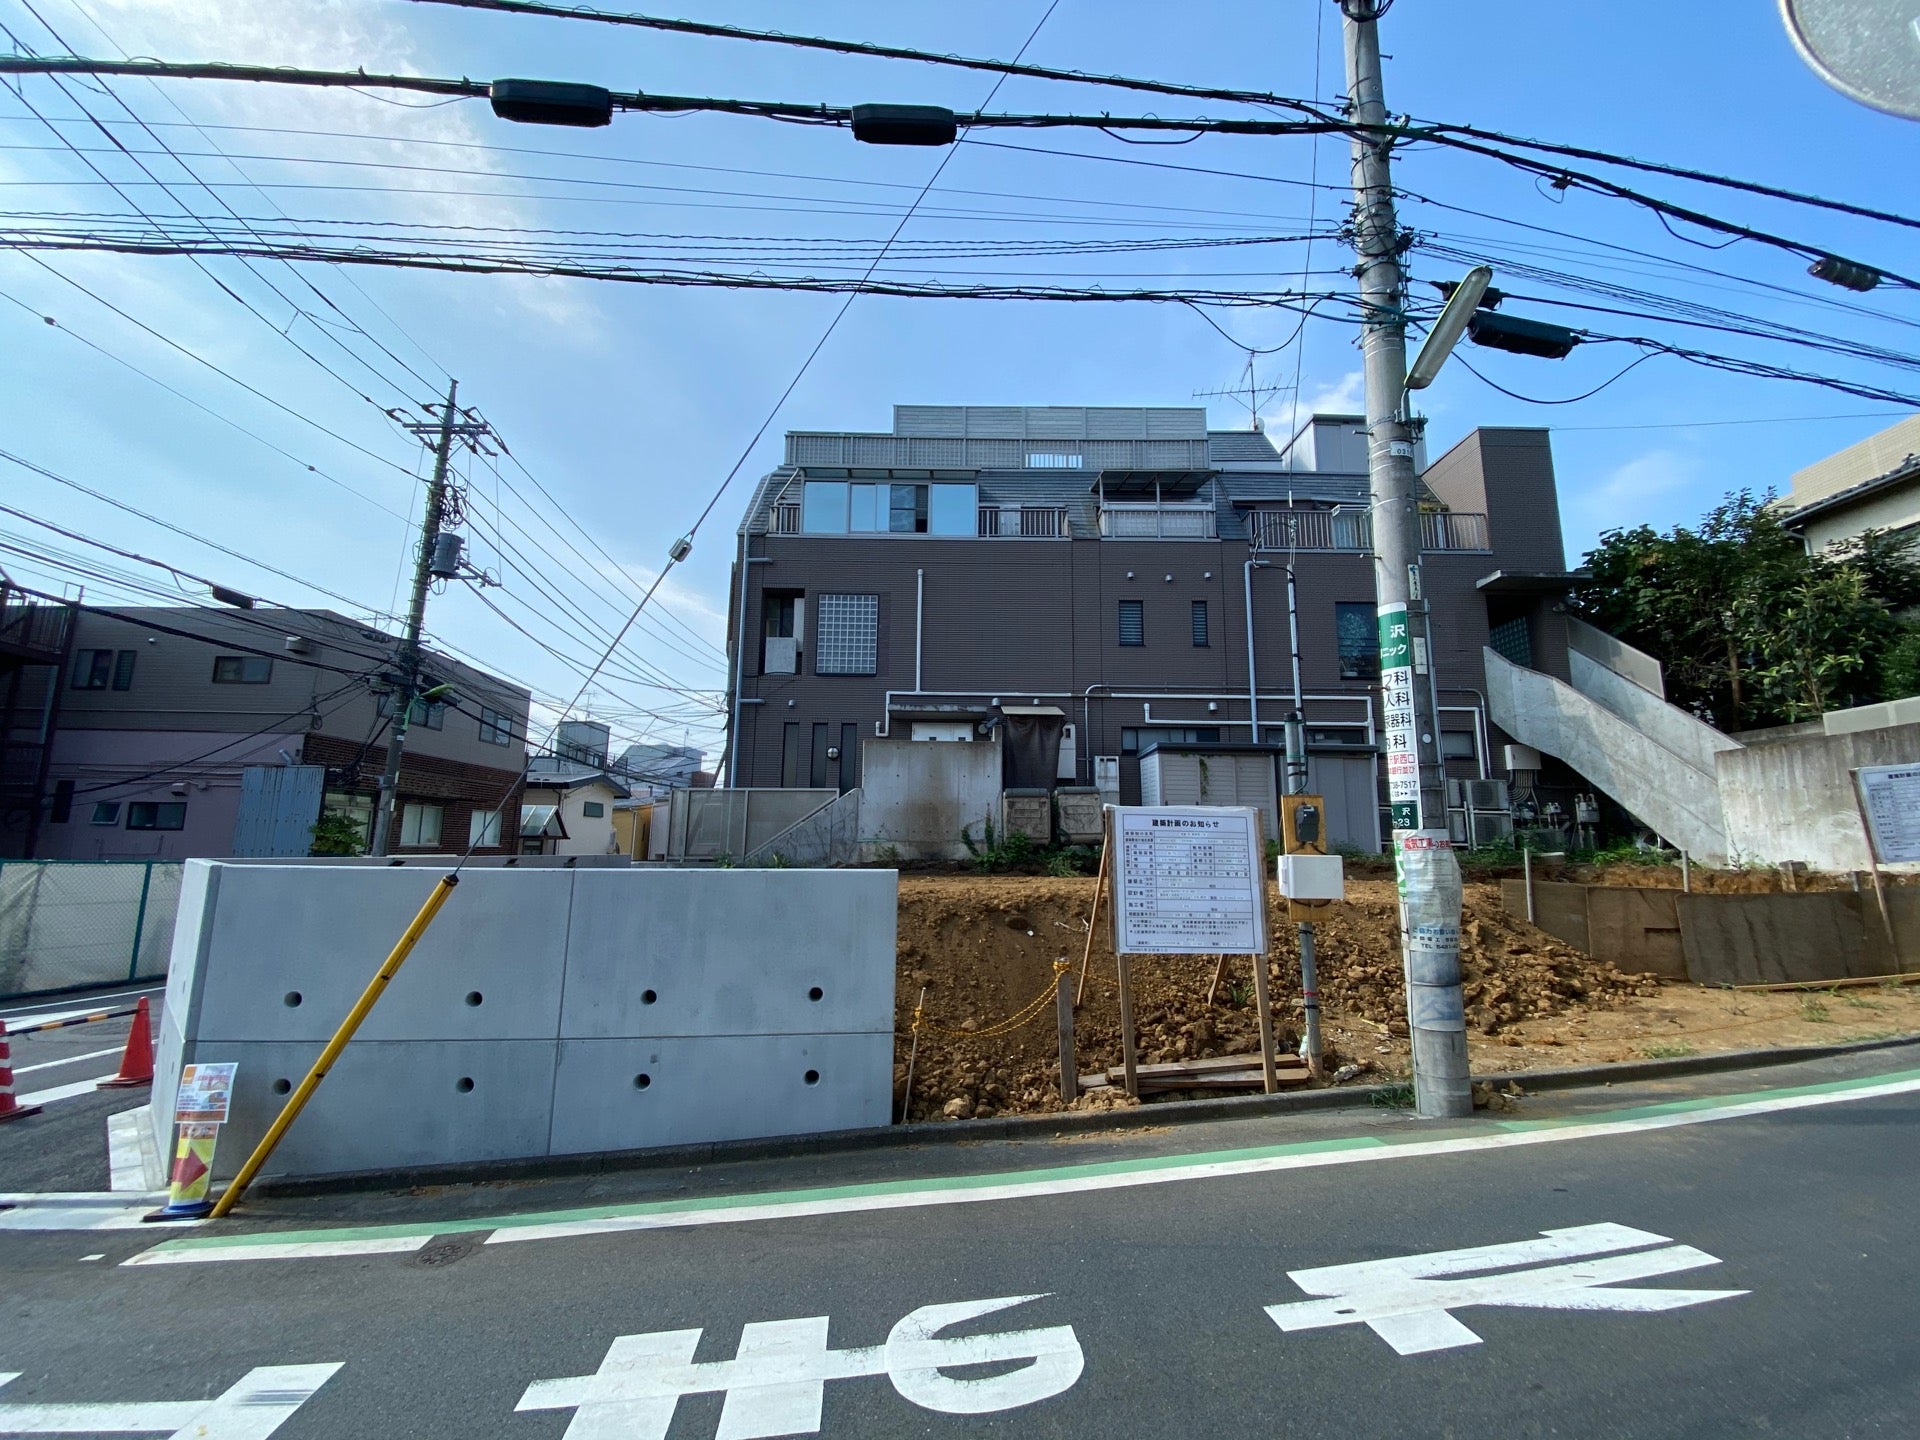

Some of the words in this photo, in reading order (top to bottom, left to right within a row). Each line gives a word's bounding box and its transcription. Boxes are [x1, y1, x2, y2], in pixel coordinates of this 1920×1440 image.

[1388, 766, 1415, 775] 銀行並び
[1152, 819, 1219, 828] 建築計画のお知らせ
